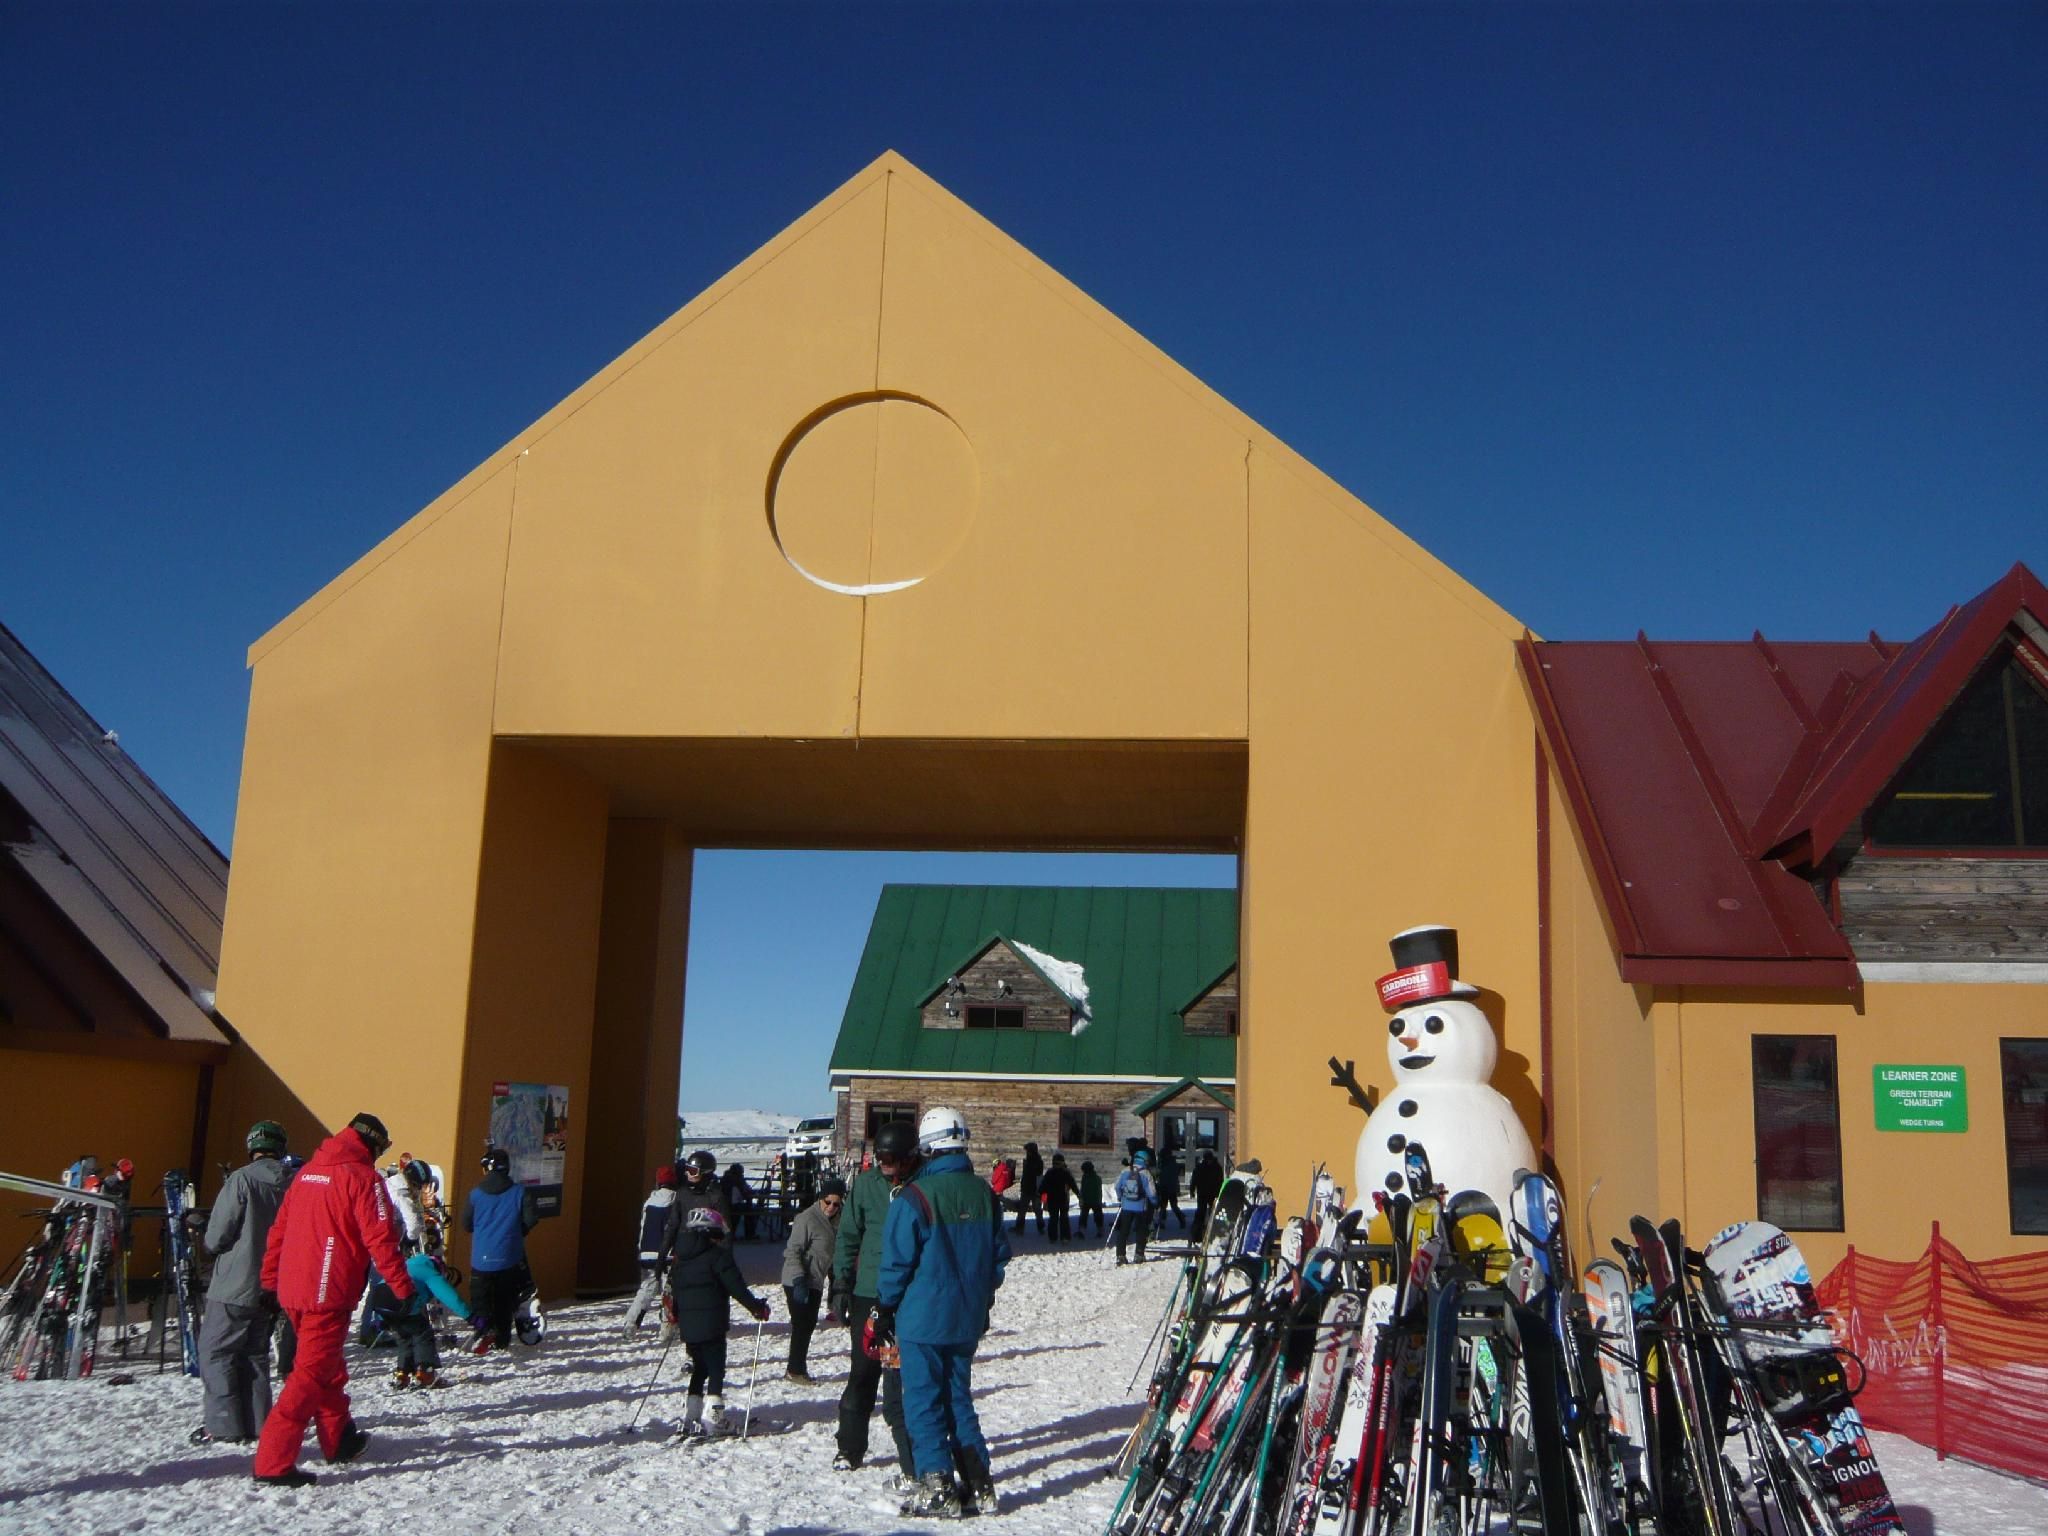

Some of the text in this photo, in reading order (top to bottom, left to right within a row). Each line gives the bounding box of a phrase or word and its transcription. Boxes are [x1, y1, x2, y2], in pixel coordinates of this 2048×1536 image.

[1382, 973, 1428, 994] CARDRONA
[1881, 1070, 1958, 1082] LEARNER ZONE
[1889, 1089, 1952, 1098] GREEN TERRAIN
[1903, 1098, 1943, 1107] CHAIRLIFT
[1899, 1119, 1944, 1127] WEDGE TURNS
[1311, 1292, 1357, 1427] SALOMON
